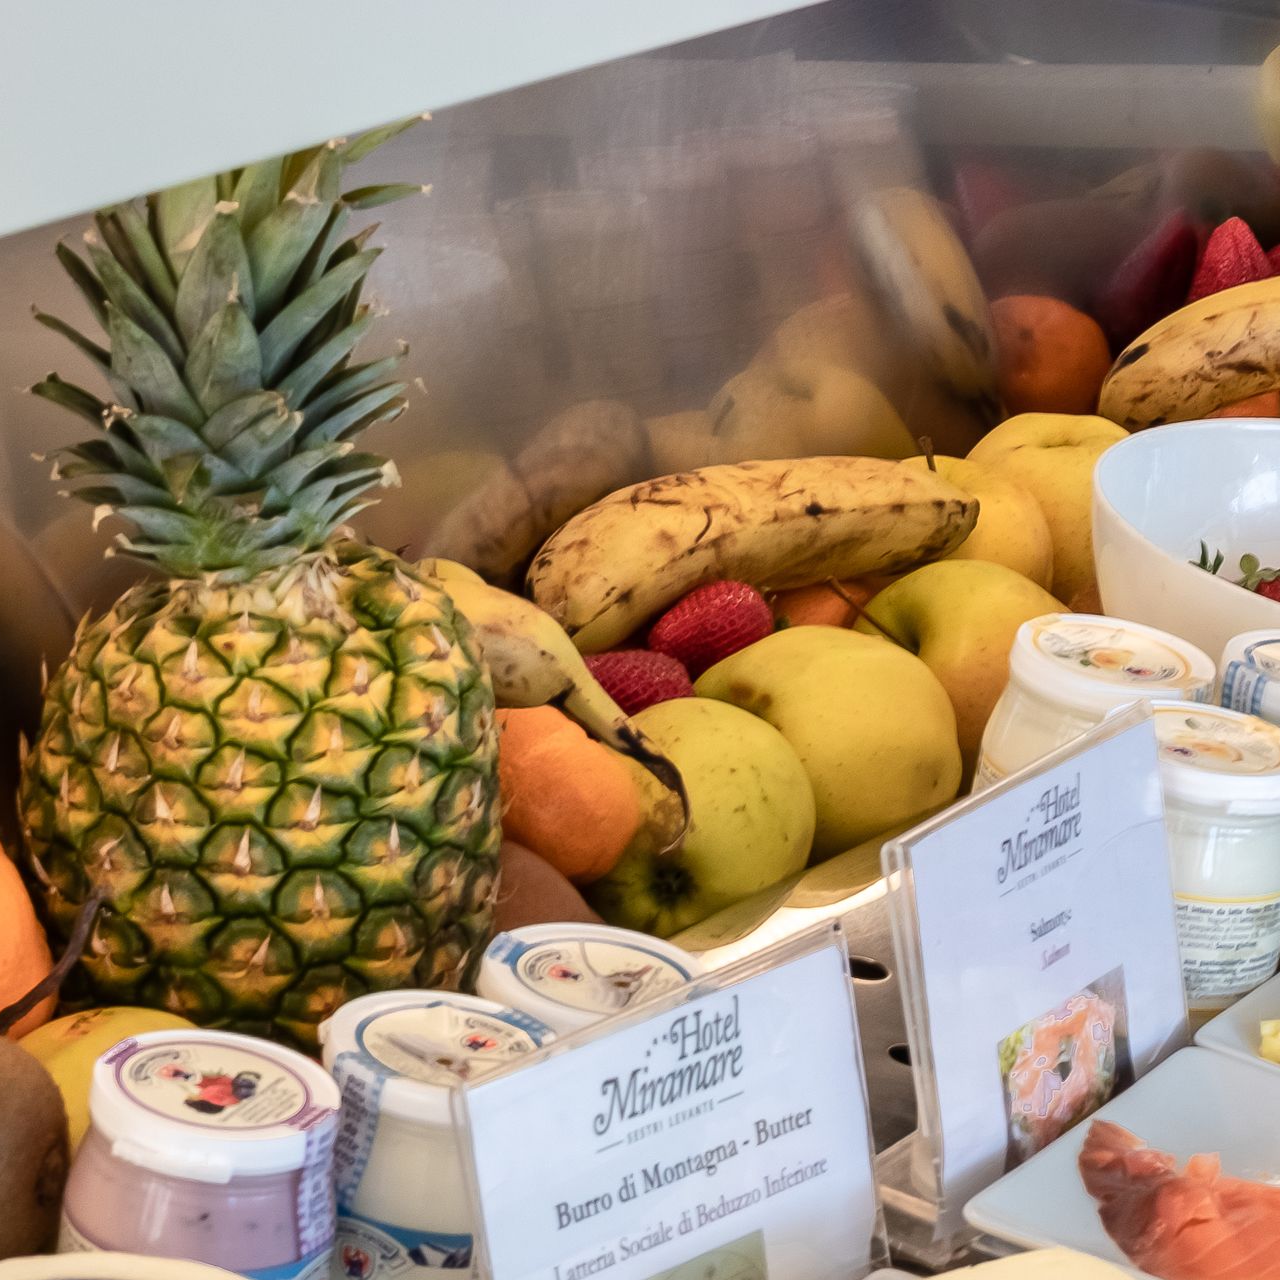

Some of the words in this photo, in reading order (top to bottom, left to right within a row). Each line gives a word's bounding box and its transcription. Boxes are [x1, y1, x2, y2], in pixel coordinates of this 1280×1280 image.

[1038, 772, 1081, 825] Hotel
[997, 811, 1082, 884] Miramare
[669, 995, 742, 1061] Hotel
[593, 1045, 744, 1137] Miramare
[626, 1120, 664, 1146] SESTRI
[668, 1099, 715, 1128] LEVANTE
[555, 1195, 613, 1230] Burro
[619, 1173, 637, 1203] di
[642, 1140, 739, 1194] Montagna
[754, 1107, 813, 1147] Butter
[620, 1221, 673, 1262] Sociale
[678, 1210, 693, 1235] di
[695, 1187, 762, 1228] Beduzzo
[763, 1157, 829, 1199] Inferiore
